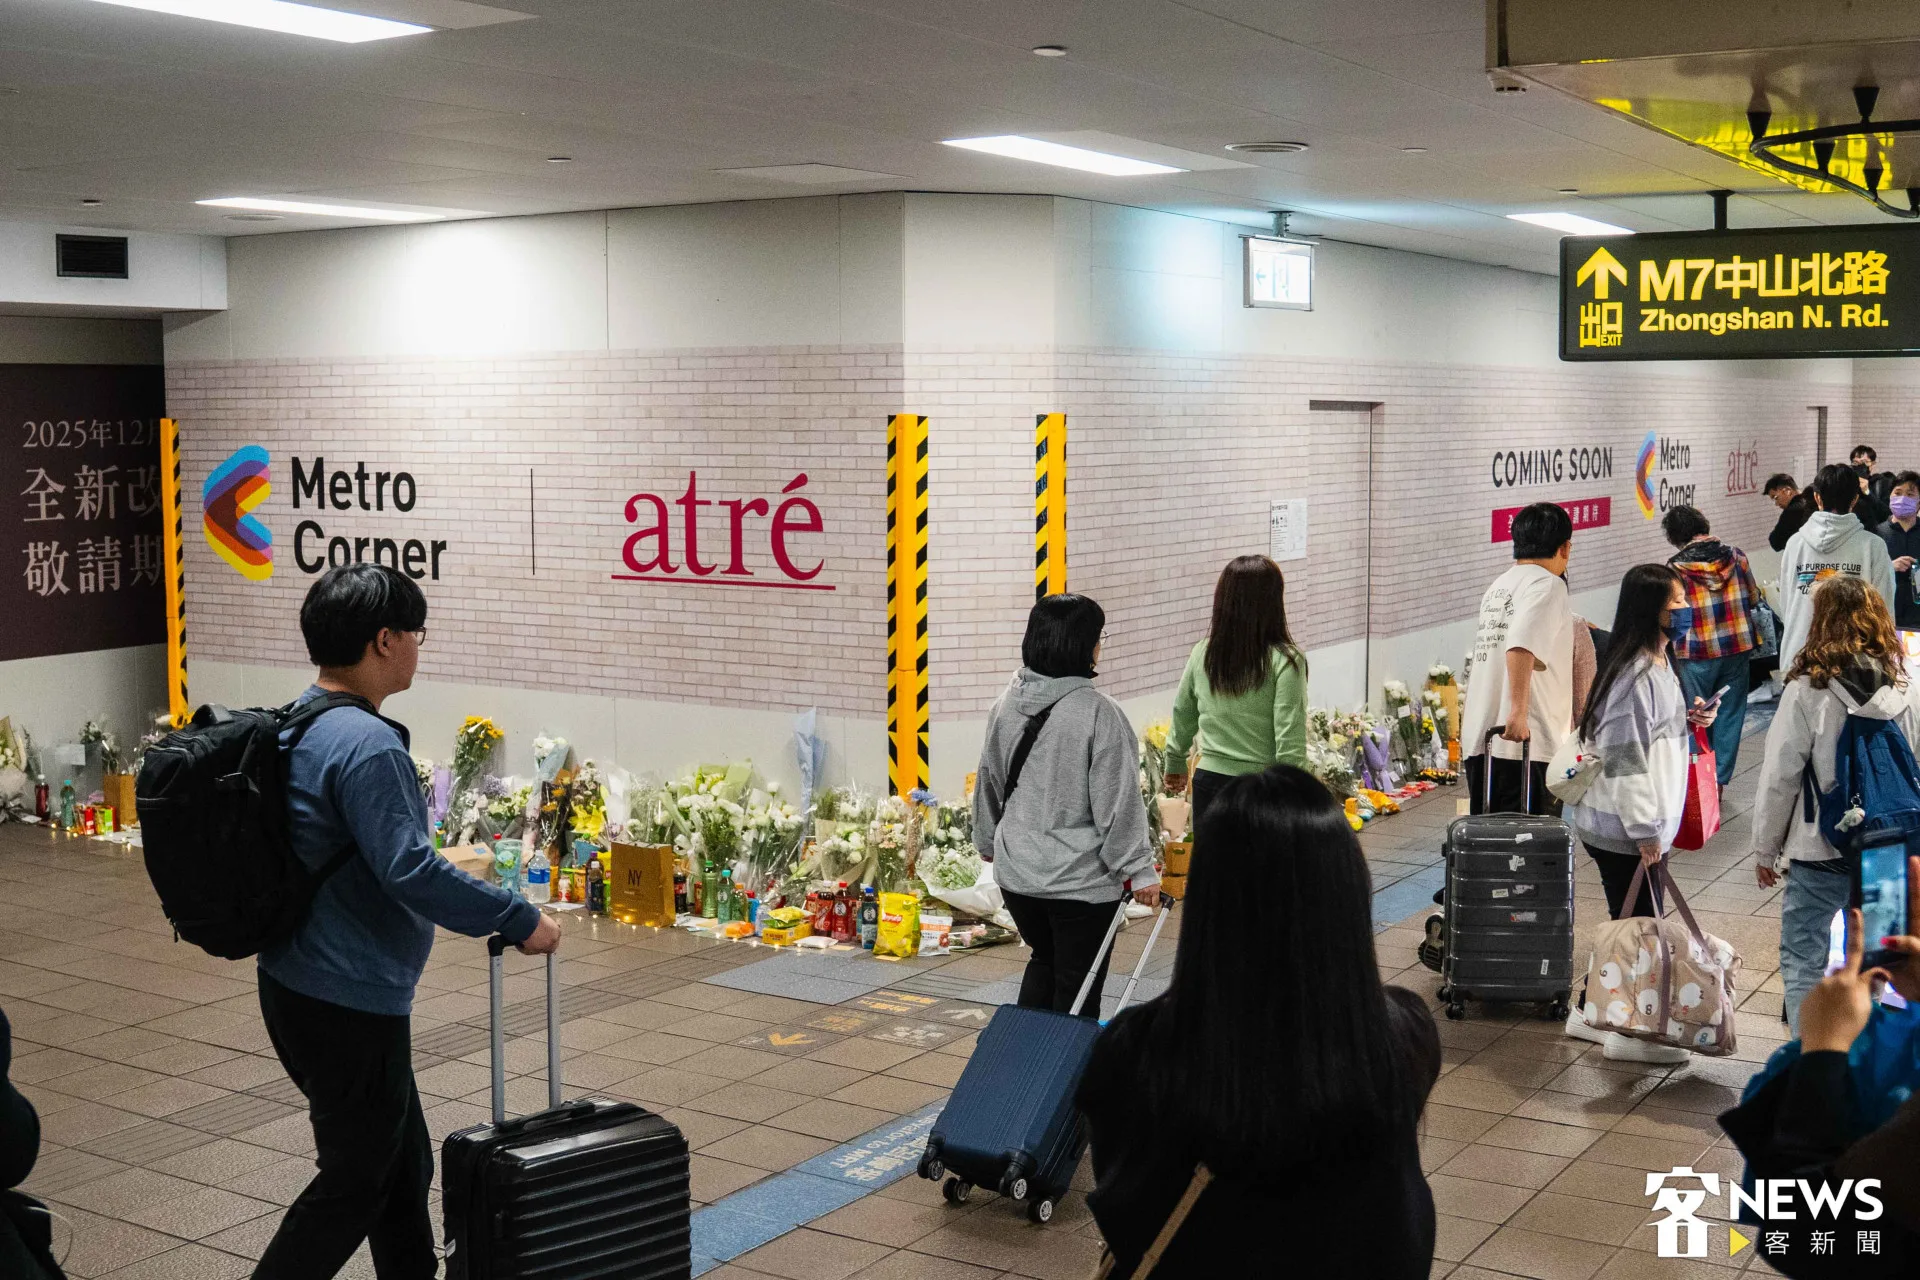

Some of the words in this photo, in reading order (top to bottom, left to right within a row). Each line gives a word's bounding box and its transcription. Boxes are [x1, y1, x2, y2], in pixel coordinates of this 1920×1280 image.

[1640, 251, 1890, 301] M7中山北路
[1579, 302, 1622, 347] 出口
[1600, 334, 1623, 346] EXIT
[1640, 307, 1793, 336] Zhongshan
[1803, 305, 1831, 329] N.
[1841, 304, 1889, 328] Rd.
[23, 419, 161, 449] 2025年12
[1660, 437, 1691, 471] Metro
[291, 456, 417, 512] Metro
[1492, 448, 1563, 488] COMING
[1568, 446, 1612, 481] SOON
[1727, 440, 1759, 492] atré
[1660, 477, 1696, 512] Corner
[622, 470, 825, 581] atré
[294, 520, 447, 580] Corner
[1841, 563, 1862, 572] CLUB
